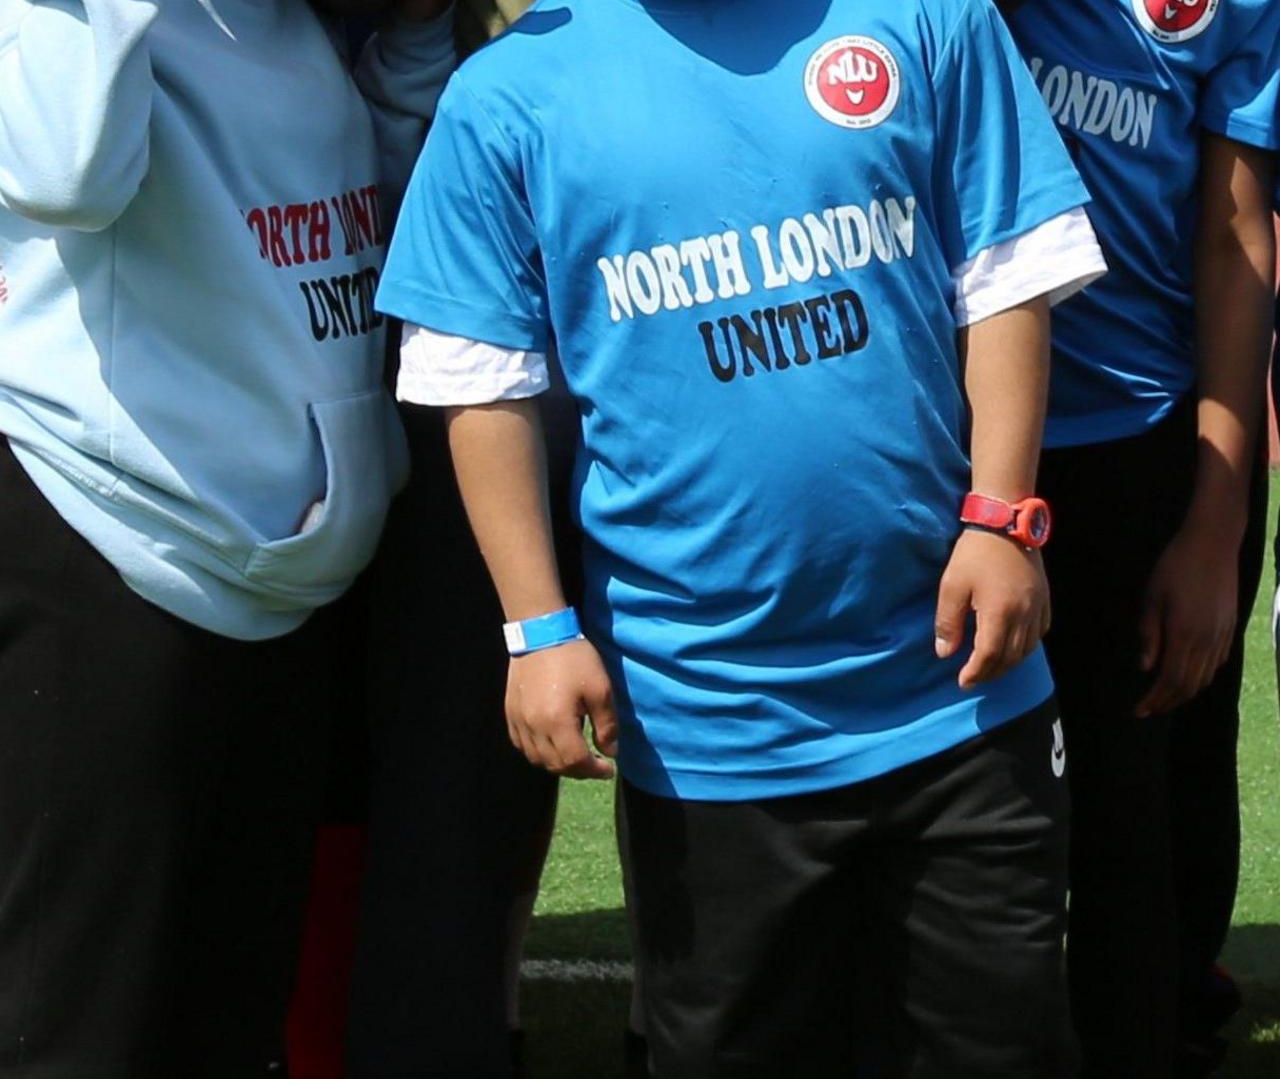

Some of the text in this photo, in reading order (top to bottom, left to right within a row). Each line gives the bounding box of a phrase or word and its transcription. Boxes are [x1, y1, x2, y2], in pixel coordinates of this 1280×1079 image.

[826, 50, 879, 86] NLU
[240, 199, 332, 268] ORTH
[598, 196, 916, 322] NORTH LONDON
[698, 288, 869, 383] UNITED
